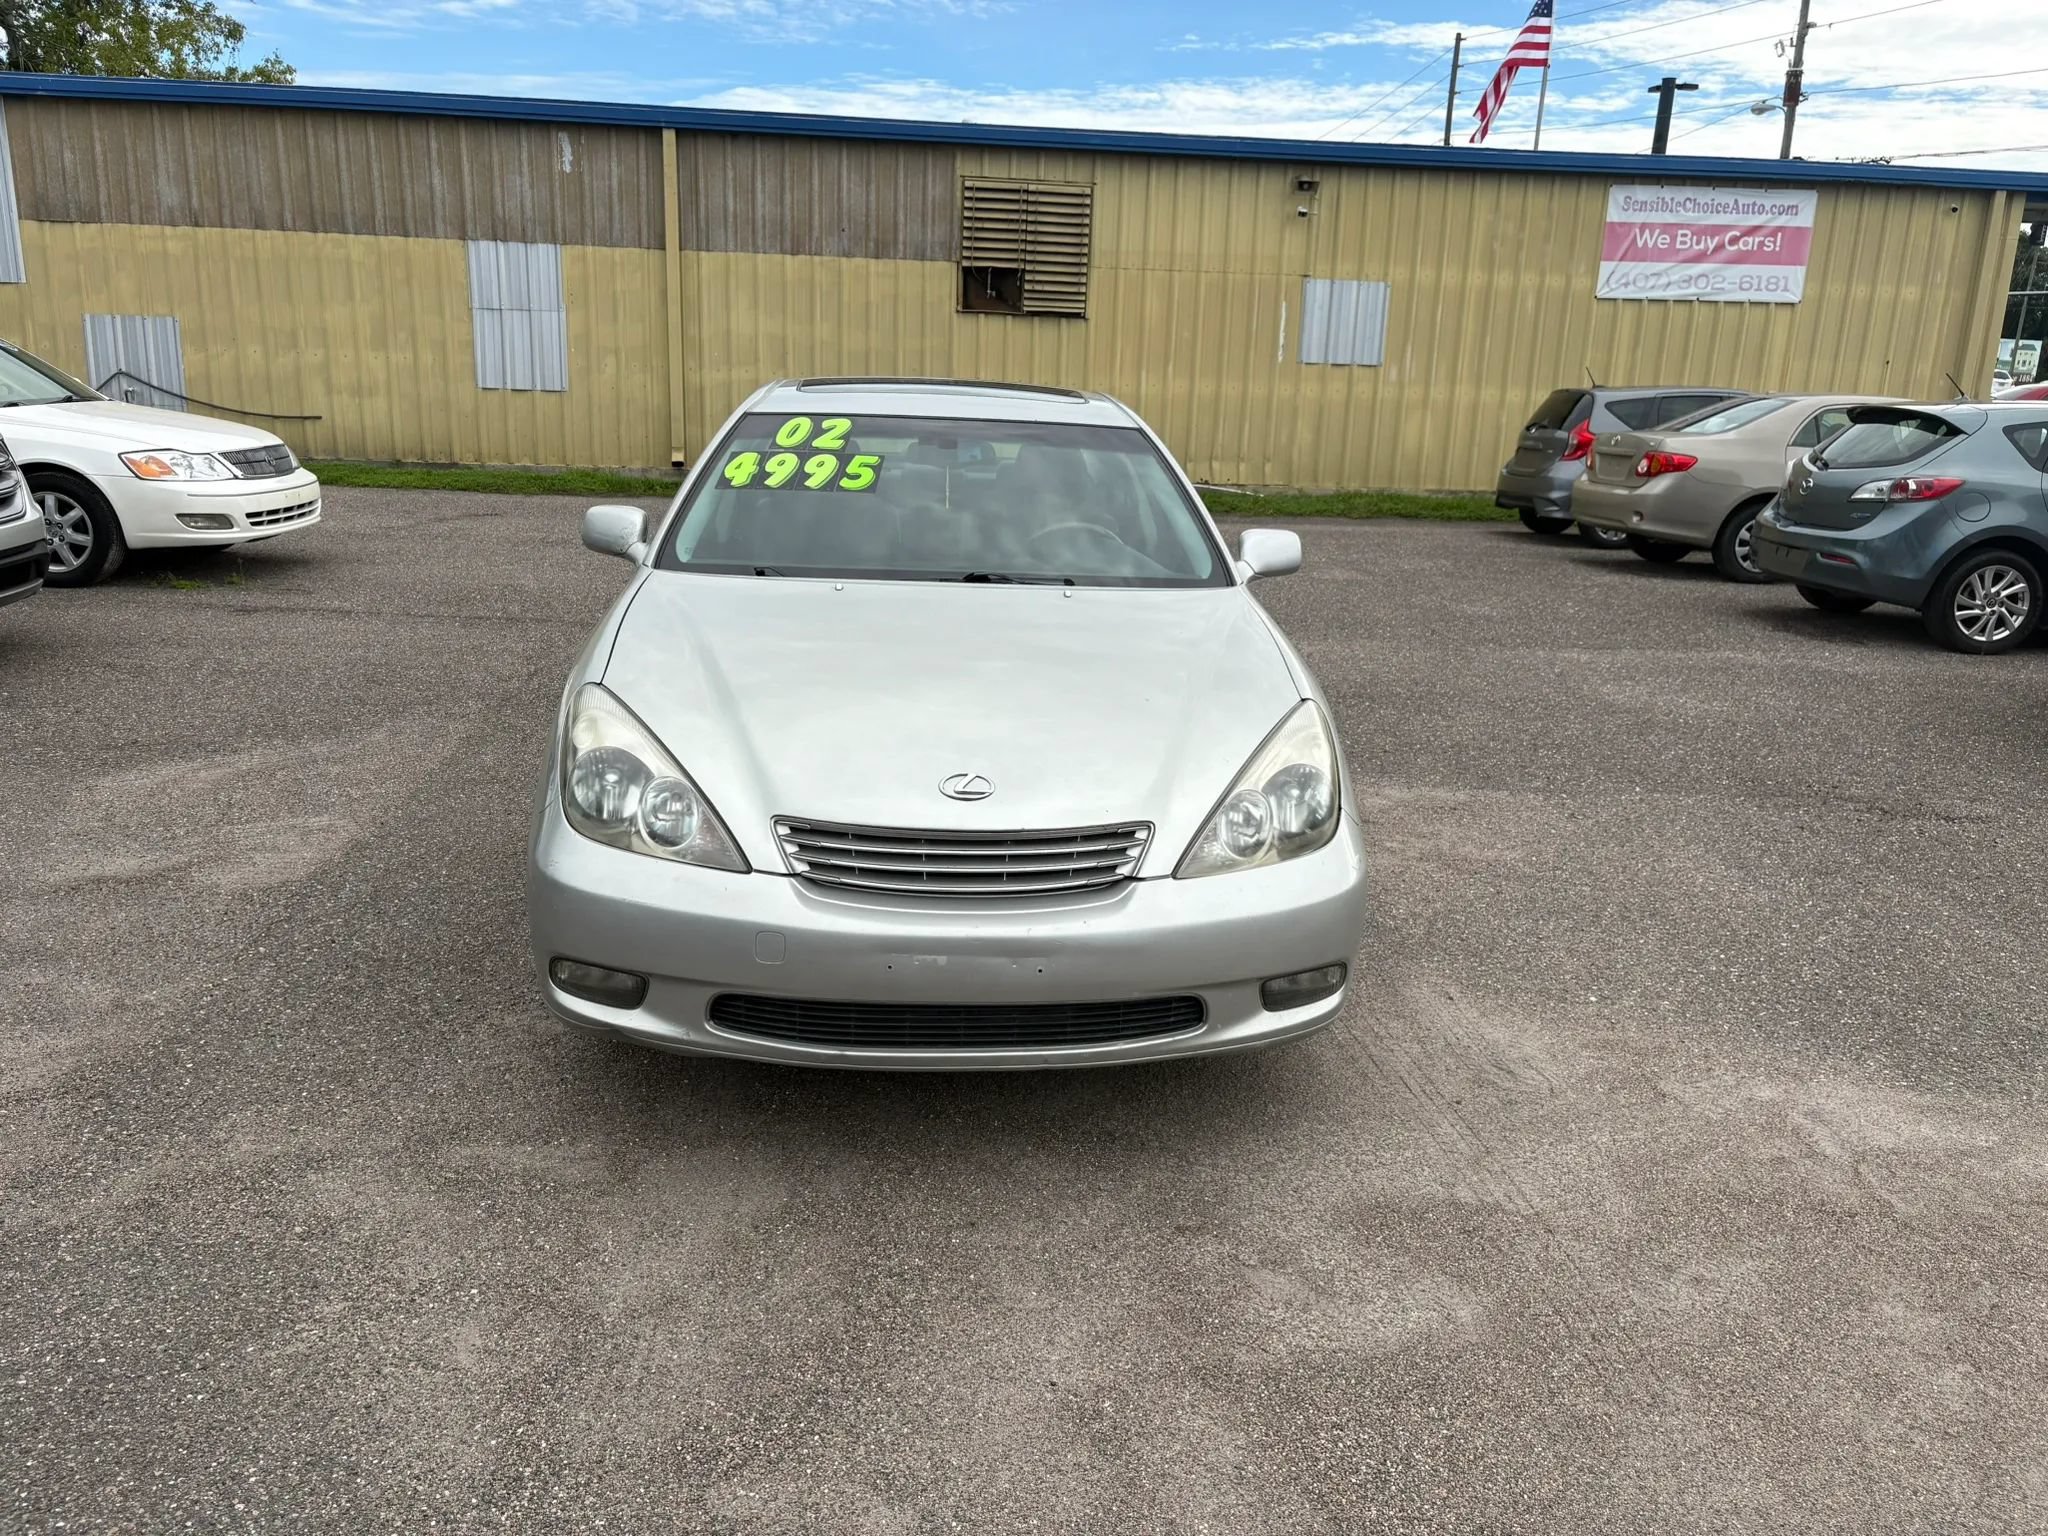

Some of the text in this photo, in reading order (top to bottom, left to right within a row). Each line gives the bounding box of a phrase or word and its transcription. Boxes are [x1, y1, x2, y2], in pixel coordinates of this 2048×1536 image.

[1622, 195, 1800, 217] SensibleChoiceAuto.com
[1635, 228, 1782, 255] We Buy Cars!
[775, 416, 853, 450] 02
[723, 451, 881, 491] 4995
